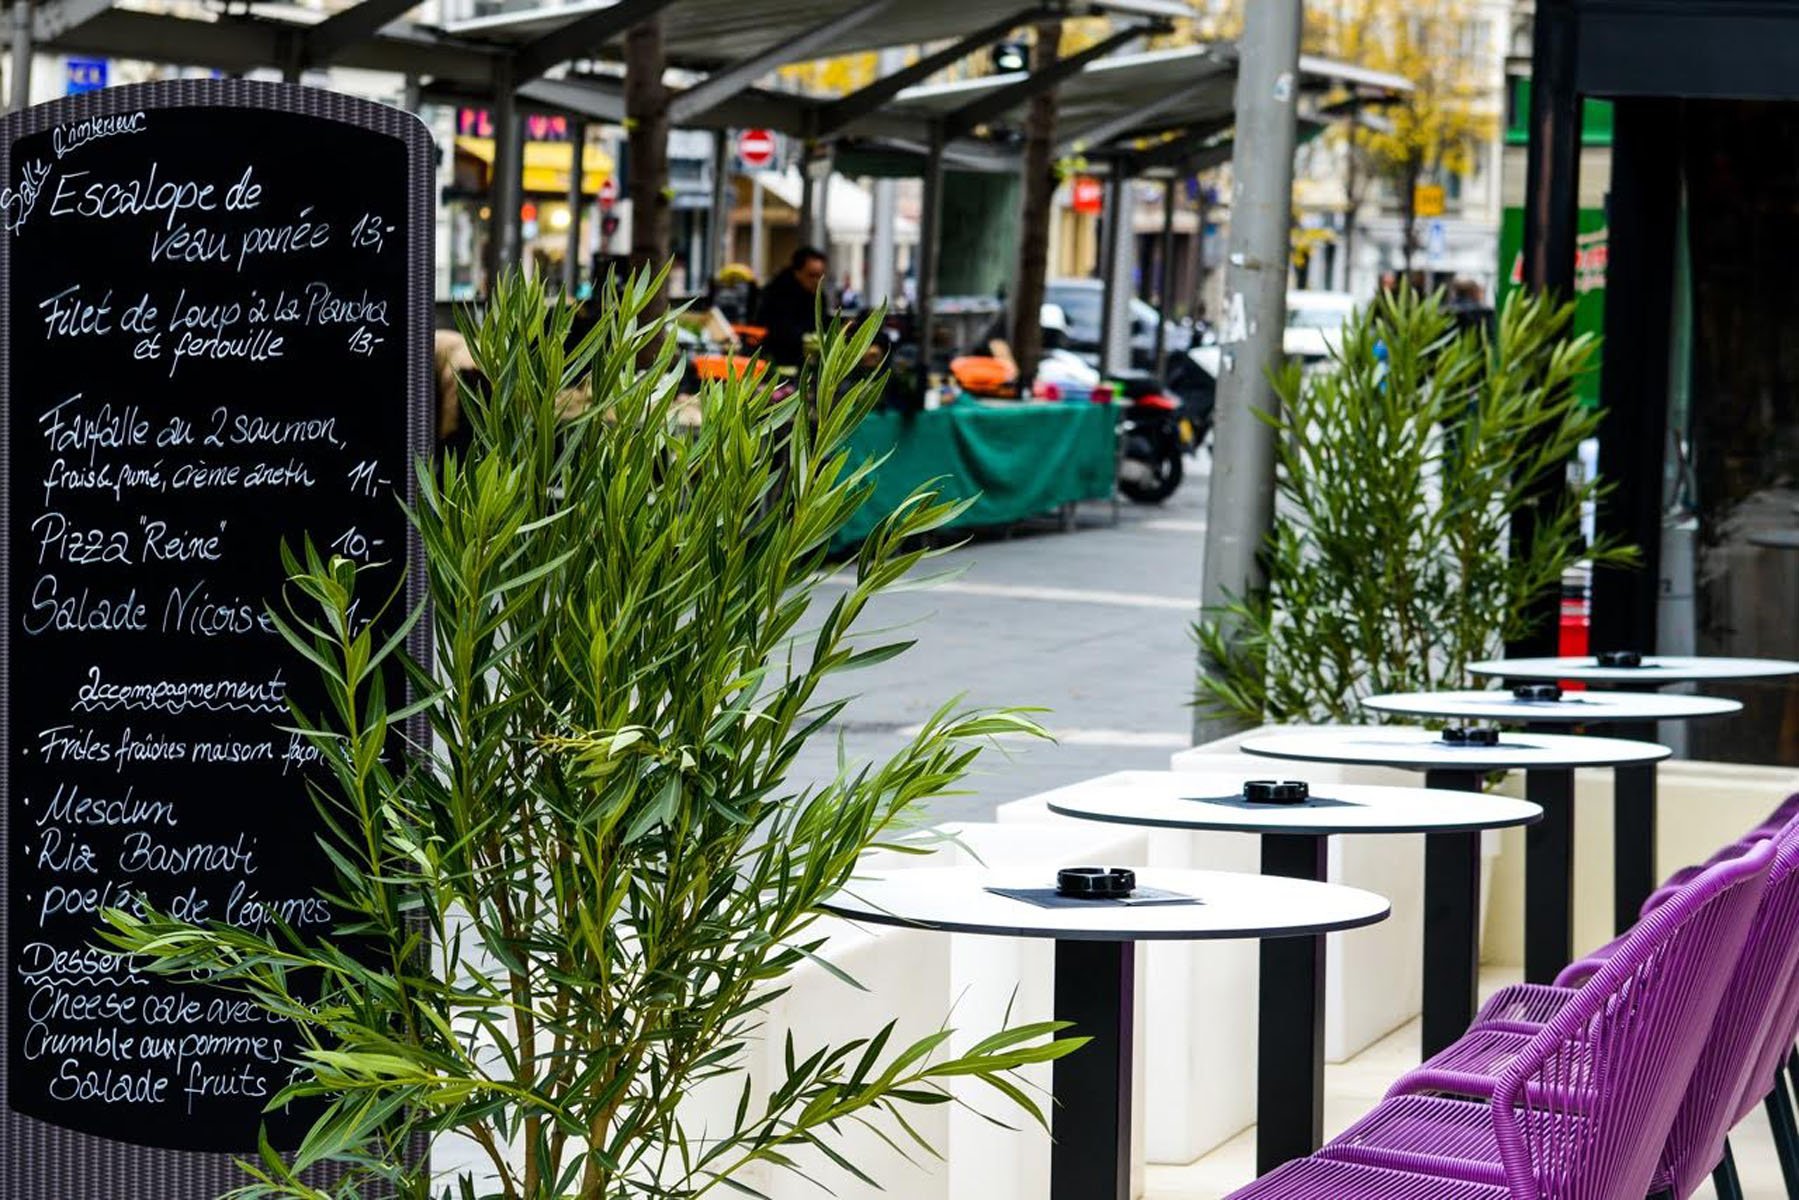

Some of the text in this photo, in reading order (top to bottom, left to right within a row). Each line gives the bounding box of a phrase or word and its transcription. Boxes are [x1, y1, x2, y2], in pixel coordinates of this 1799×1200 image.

[50, 162, 262, 228] Escalope de
[237, 206, 330, 271] panée
[39, 284, 113, 340] Filet
[120, 293, 158, 334] de
[305, 281, 390, 327] Plancha
[134, 332, 161, 360] et
[169, 329, 284, 378] fenouille
[39, 392, 149, 467] Farfalle
[156, 416, 195, 448] au
[204, 406, 227, 447] 2
[244, 457, 315, 489] aneth
[31, 512, 133, 565] Pizza
[22, 574, 148, 636] Salade
[162, 580, 280, 637] Niçoise
[38, 725, 110, 763] Frites
[192, 733, 273, 763] maison
[36, 783, 178, 827] Mesclun
[119, 832, 258, 875] Basmati
[171, 887, 210, 926] de
[225, 880, 331, 937] légumes
[28, 985, 137, 1024] Cheese
[208, 998, 261, 1024] avec
[24, 1022, 282, 1076] Crumble aux pommes
[50, 1058, 168, 1103] Salade
[184, 1060, 267, 1115] fruits
